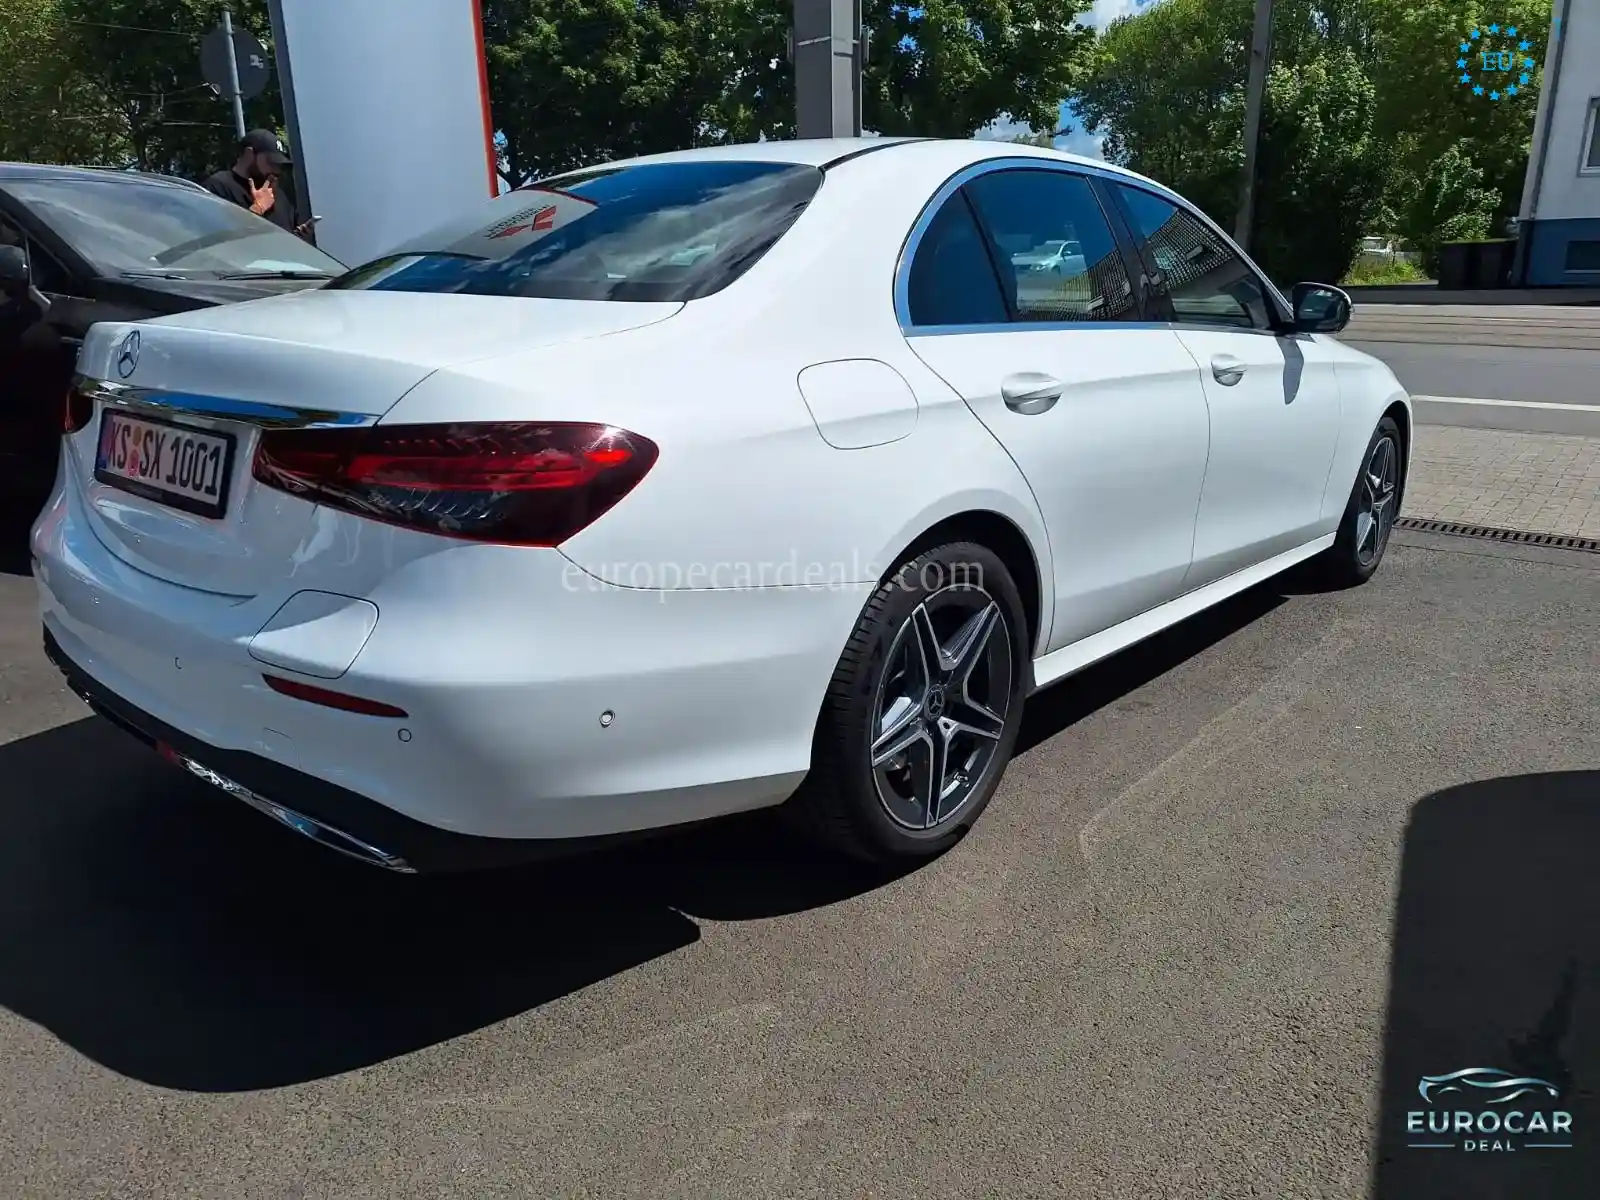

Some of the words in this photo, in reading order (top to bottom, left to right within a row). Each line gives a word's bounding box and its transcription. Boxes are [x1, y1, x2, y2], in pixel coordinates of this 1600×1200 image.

[109, 421, 130, 469] KS
[140, 431, 166, 480] SX
[166, 436, 219, 496] 1001
